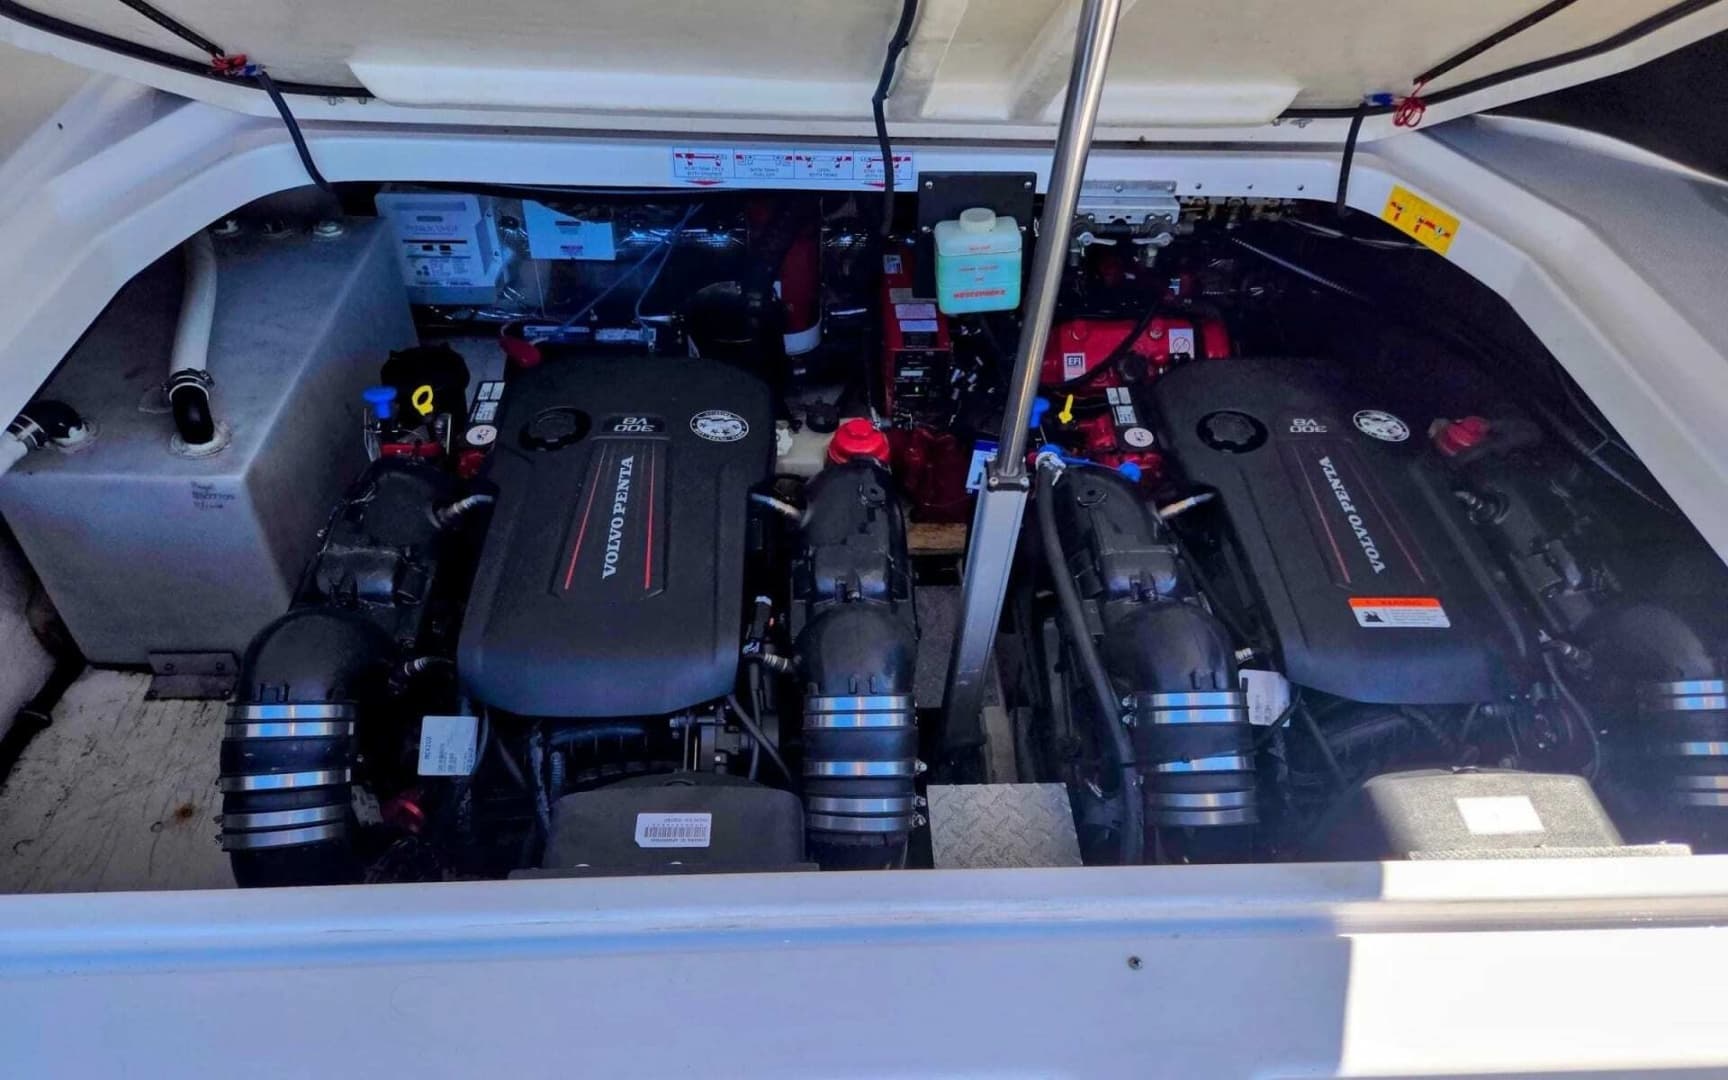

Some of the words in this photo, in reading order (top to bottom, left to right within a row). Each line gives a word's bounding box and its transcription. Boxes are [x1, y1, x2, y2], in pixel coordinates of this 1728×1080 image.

[1067, 356, 1083, 367] EFI
[621, 416, 648, 425] V8
[1292, 417, 1318, 426] V8
[613, 424, 656, 433] 300
[1289, 424, 1328, 433] 300
[1318, 455, 1356, 513] PENTA
[602, 516, 624, 579] VOLVO
[613, 455, 635, 516] PENTA
[1347, 513, 1386, 575] VOLVO
